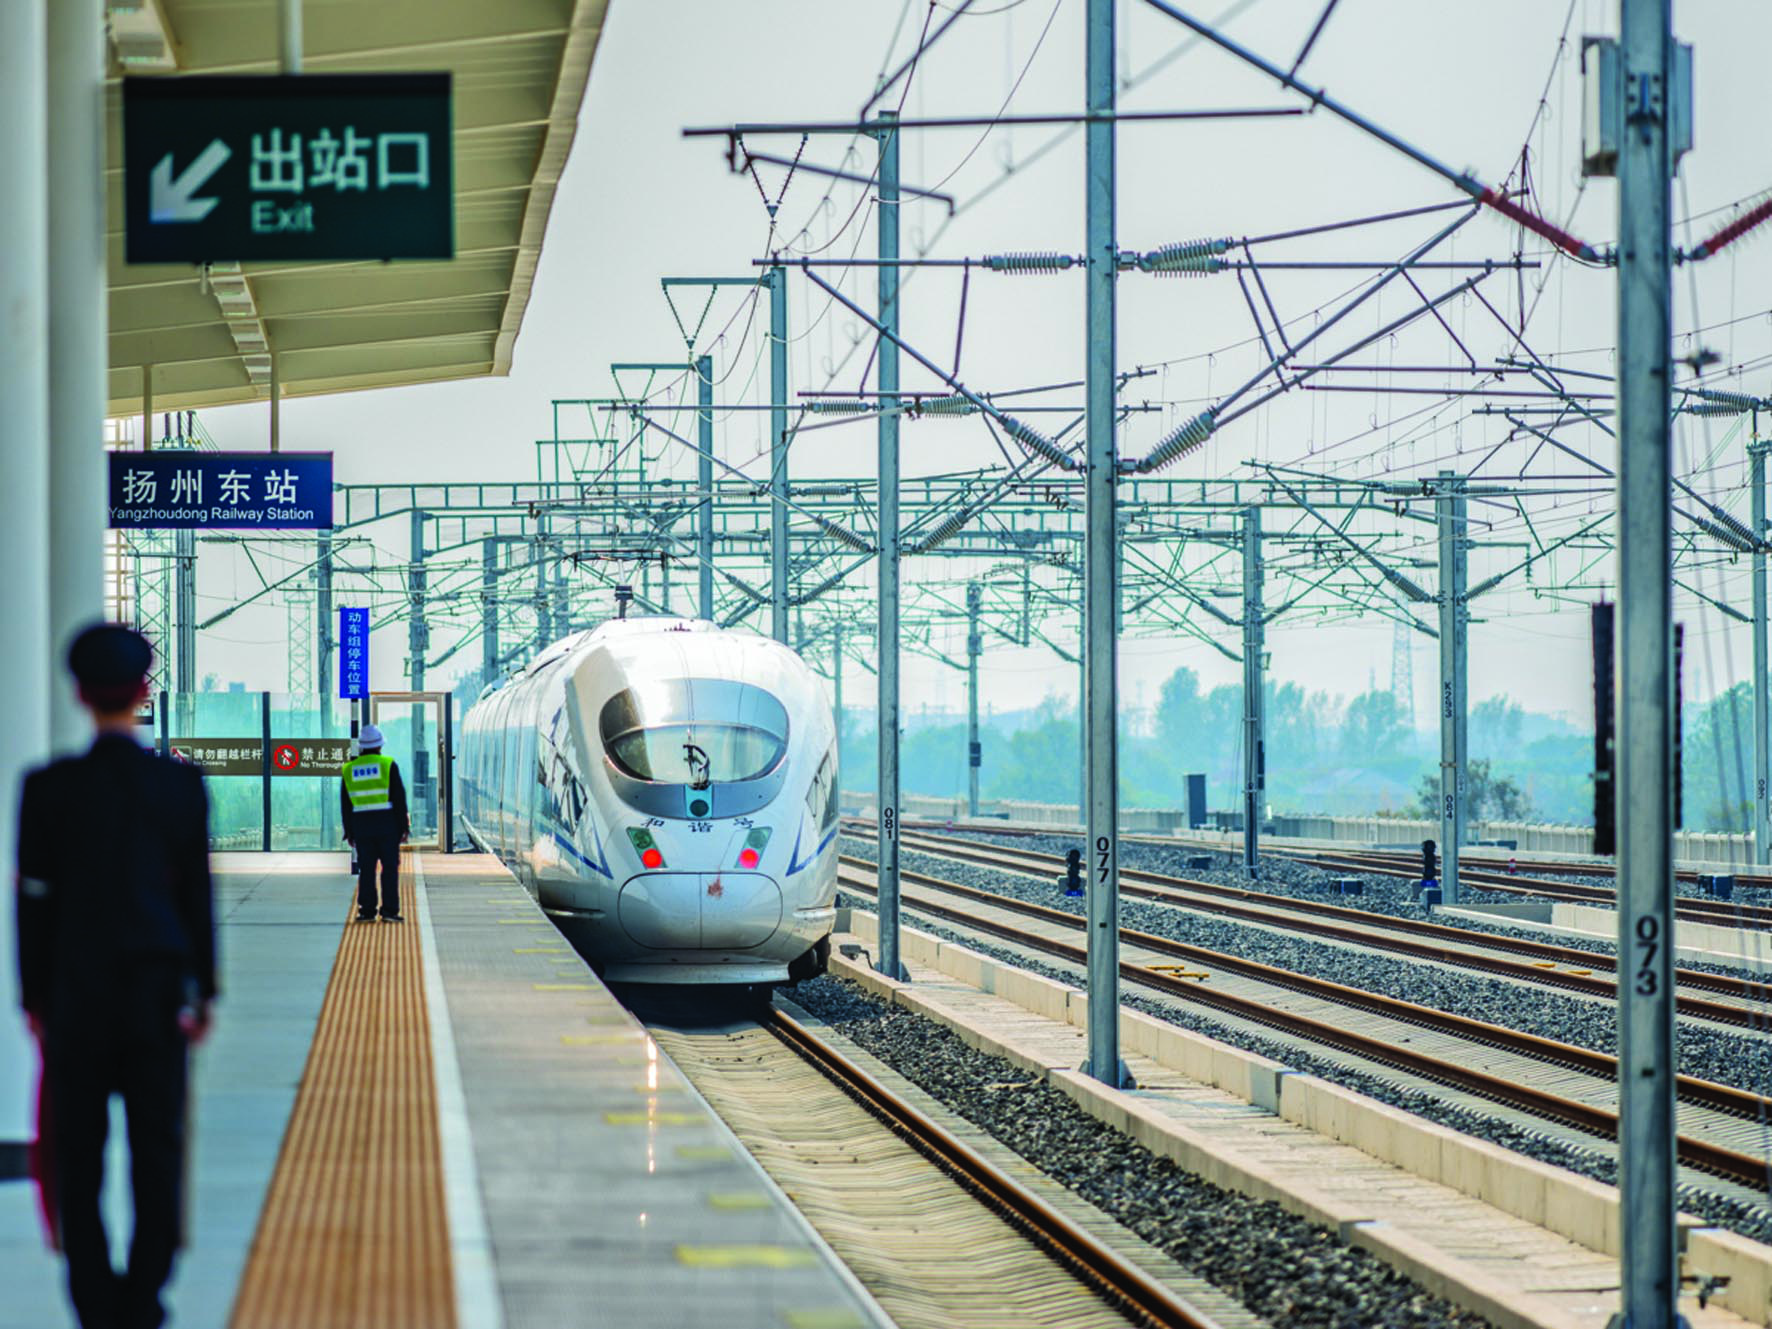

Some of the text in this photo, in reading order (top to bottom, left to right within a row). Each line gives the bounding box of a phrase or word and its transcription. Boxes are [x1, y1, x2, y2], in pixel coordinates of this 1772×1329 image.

[250, 126, 429, 193] 出站口
[251, 200, 314, 233] Exit
[122, 468, 299, 504] 扬州东站
[109, 506, 314, 522] Yangzhoudong Railway Station
[347, 612, 361, 695] 动车组停车位置
[884, 807, 893, 839] 081
[1096, 836, 1110, 883] 077
[1636, 914, 1659, 996] 073
